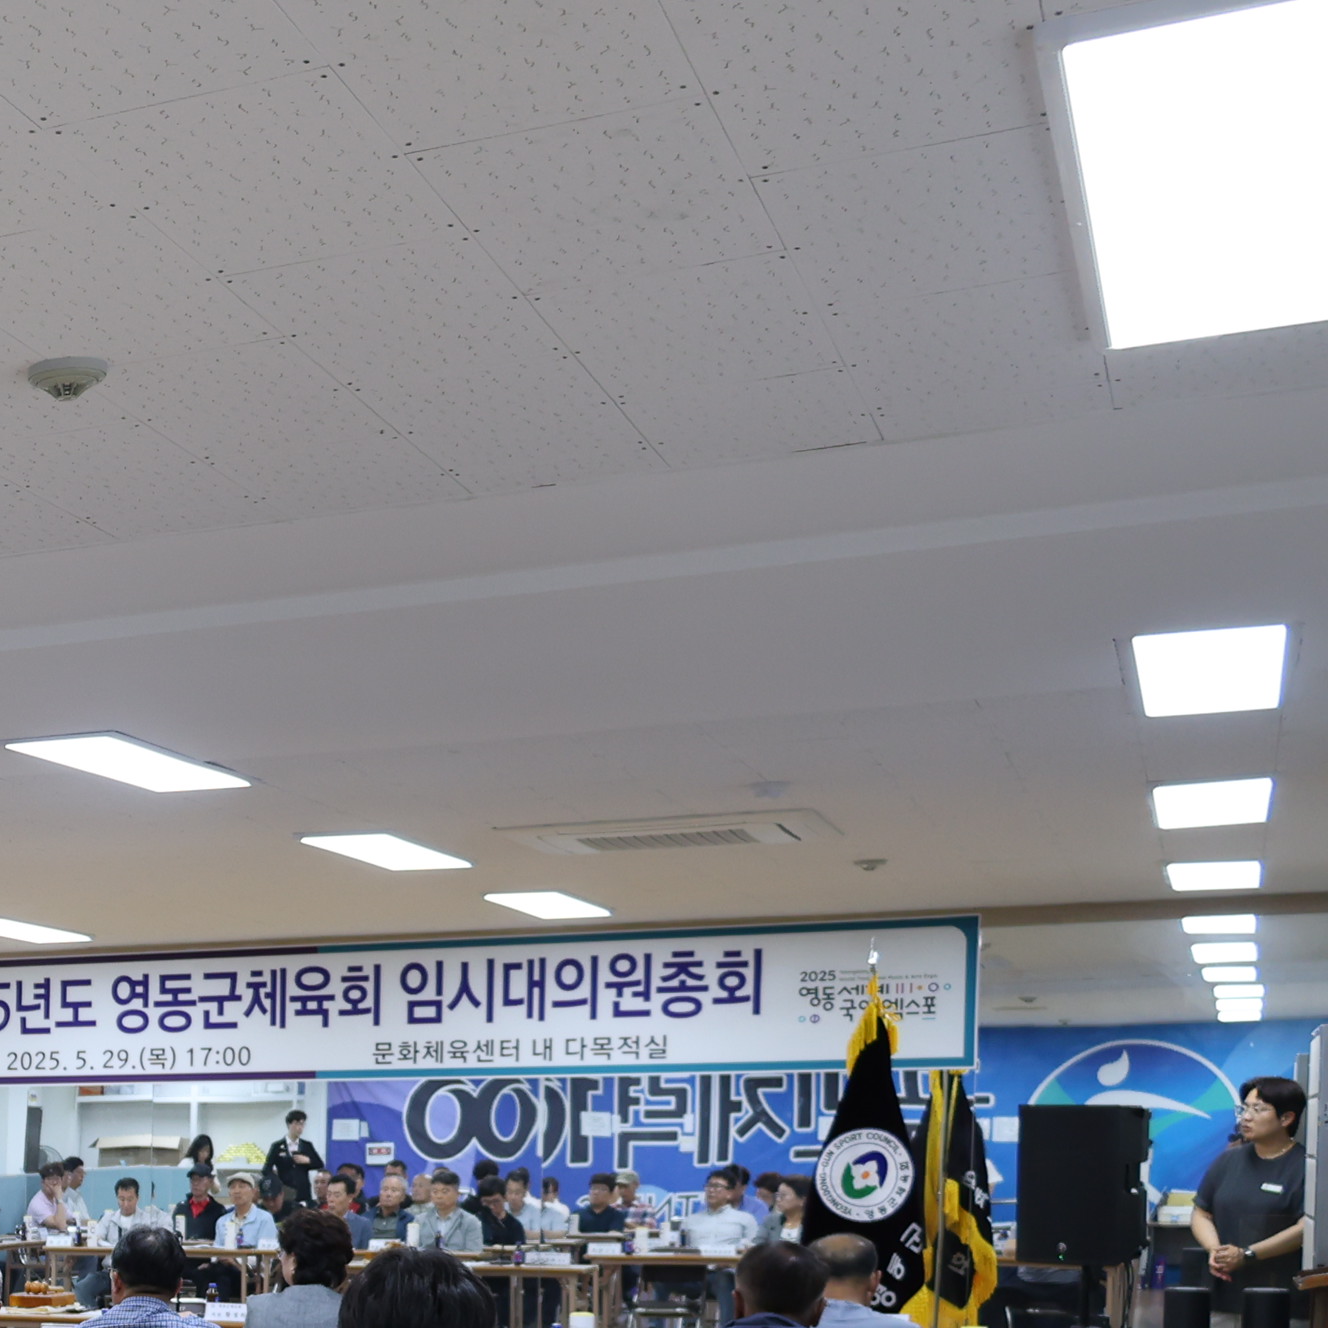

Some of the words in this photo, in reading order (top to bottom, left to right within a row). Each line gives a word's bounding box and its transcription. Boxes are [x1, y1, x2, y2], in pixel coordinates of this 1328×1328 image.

[799, 969, 837, 983] 2025
[111, 963, 382, 1035] 영동군체육회
[398, 947, 764, 1026] 임시대의원총회
[839, 995, 937, 1022] 국엑스포
[185, 1046, 252, 1068] 17:00
[371, 1037, 521, 1065] 문화체육센터
[531, 1037, 554, 1063] 내
[564, 1034, 669, 1062] 다목적실
[833, 1132, 863, 1151] SPORT
